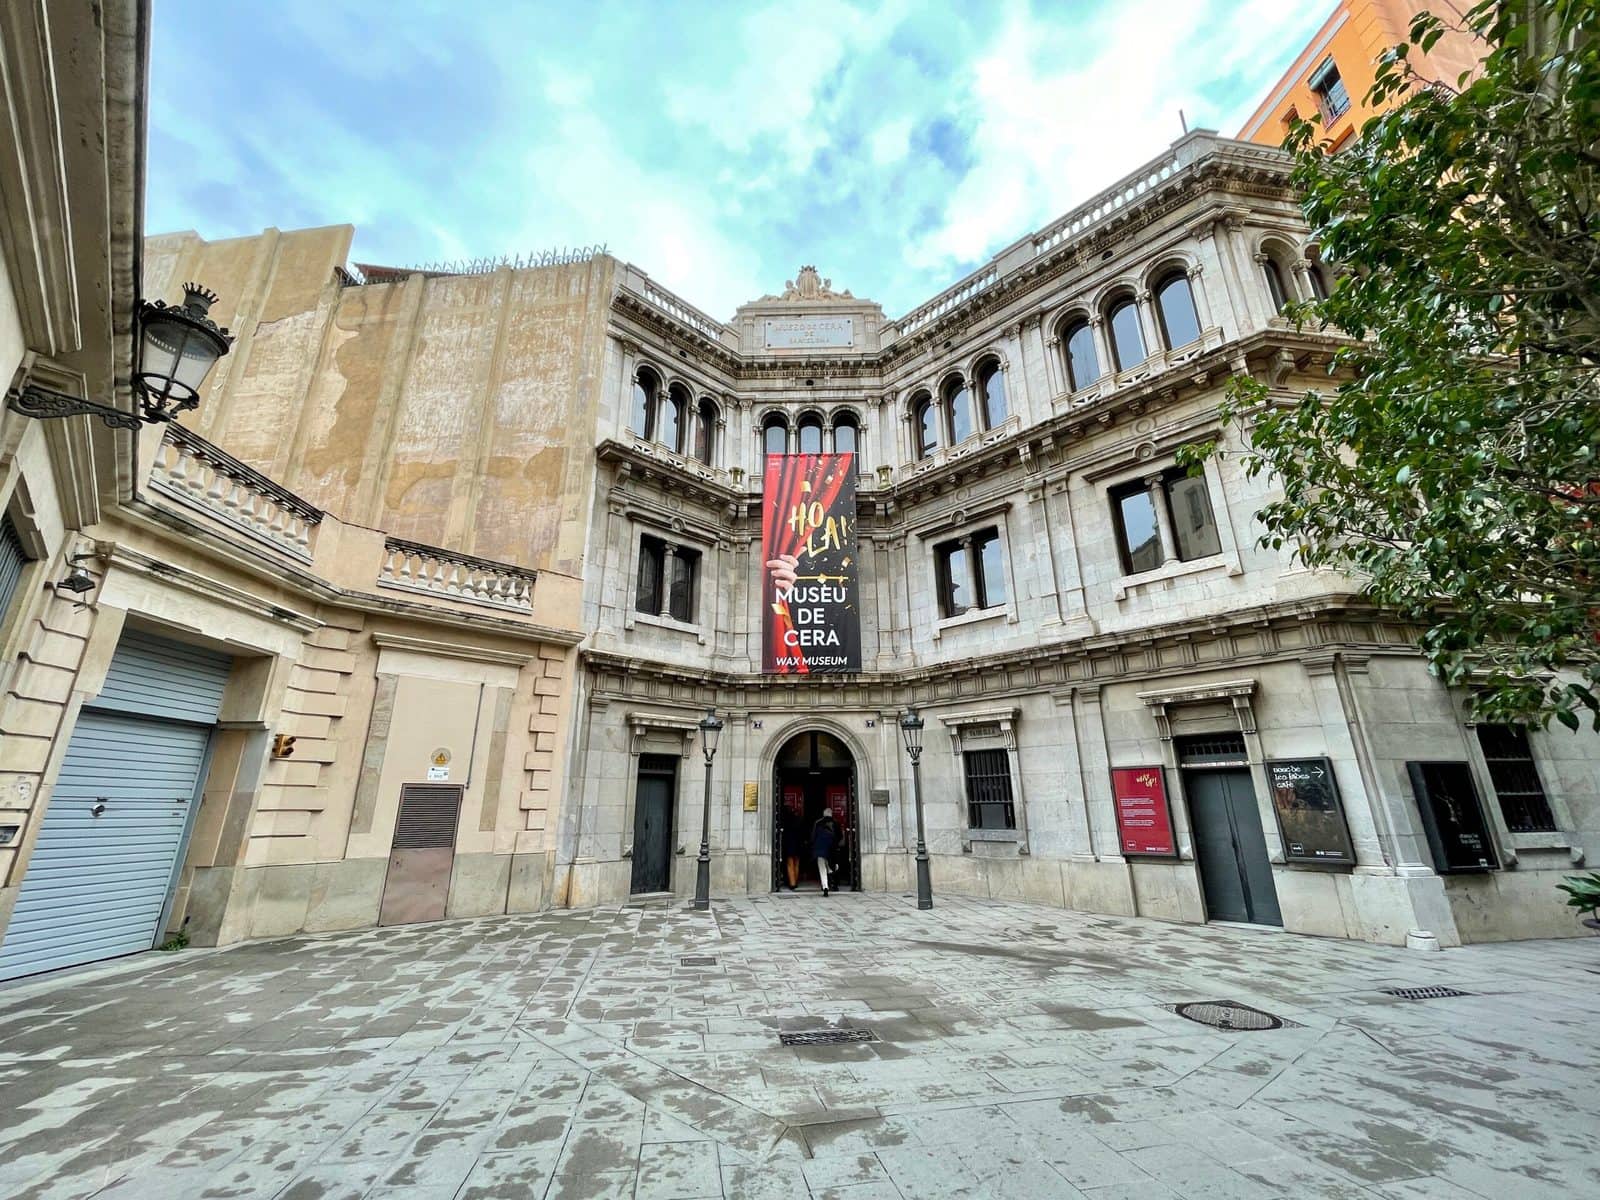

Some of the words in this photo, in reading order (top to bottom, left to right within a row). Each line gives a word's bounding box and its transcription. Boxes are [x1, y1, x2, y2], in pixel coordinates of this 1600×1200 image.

[775, 586, 846, 604] MUSEU
[797, 607, 825, 625] DE
[783, 629, 841, 647] CERA
[776, 656, 800, 666] WAX
[801, 655, 848, 665] MUSEUM
